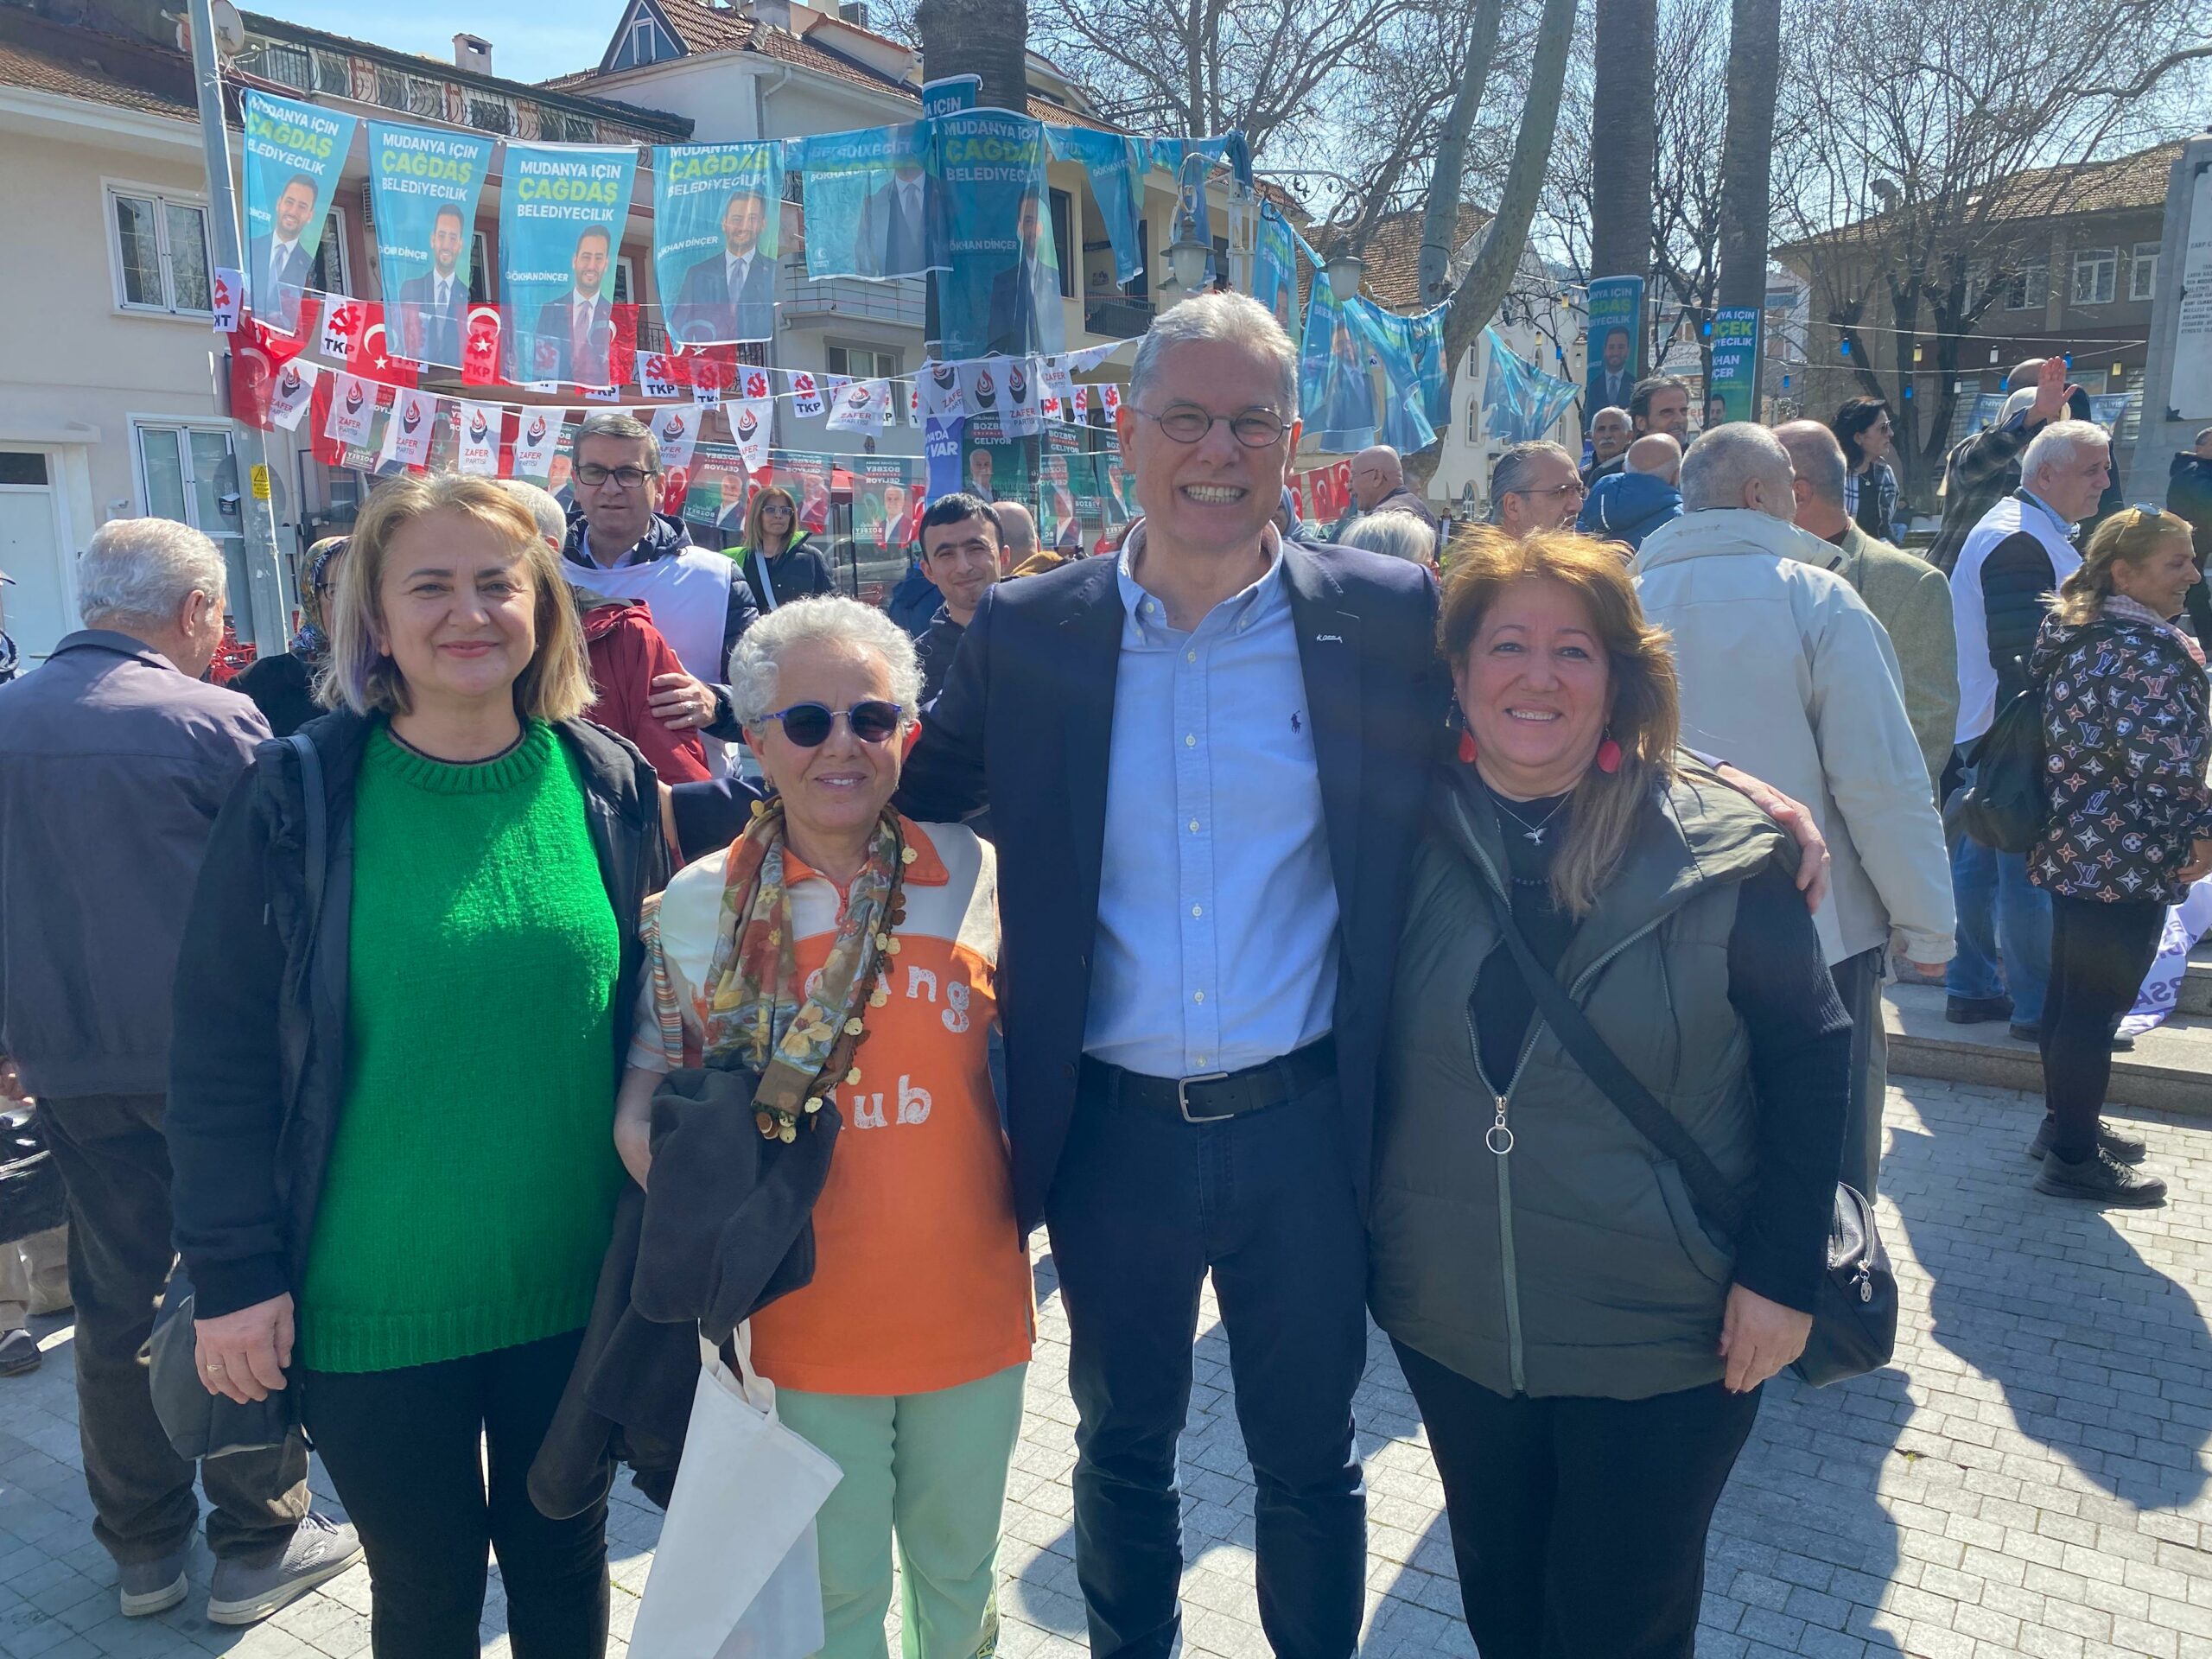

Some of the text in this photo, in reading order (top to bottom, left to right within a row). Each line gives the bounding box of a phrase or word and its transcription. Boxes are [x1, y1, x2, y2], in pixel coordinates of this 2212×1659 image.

[944, 120, 1014, 137] MUDANYA
[383, 132, 445, 155] MUDANYA
[381, 149, 473, 185] ÇAĞDAŞ
[520, 161, 588, 178] MUDANYA
[518, 177, 619, 206] ÇAĞDAŞ
[325, 337, 355, 355] TKP
[463, 361, 490, 378] TKP
[646, 384, 675, 395] TKP
[270, 398, 293, 412] ZAFER
[942, 389, 962, 408] ZAFE
[797, 402, 821, 413] TKP
[339, 416, 361, 429] ZAFER
[397, 437, 418, 448] ZAFER
[1048, 429, 1077, 442] BOZBEY
[464, 448, 489, 458] ZAFER
[931, 441, 958, 457] VAR
